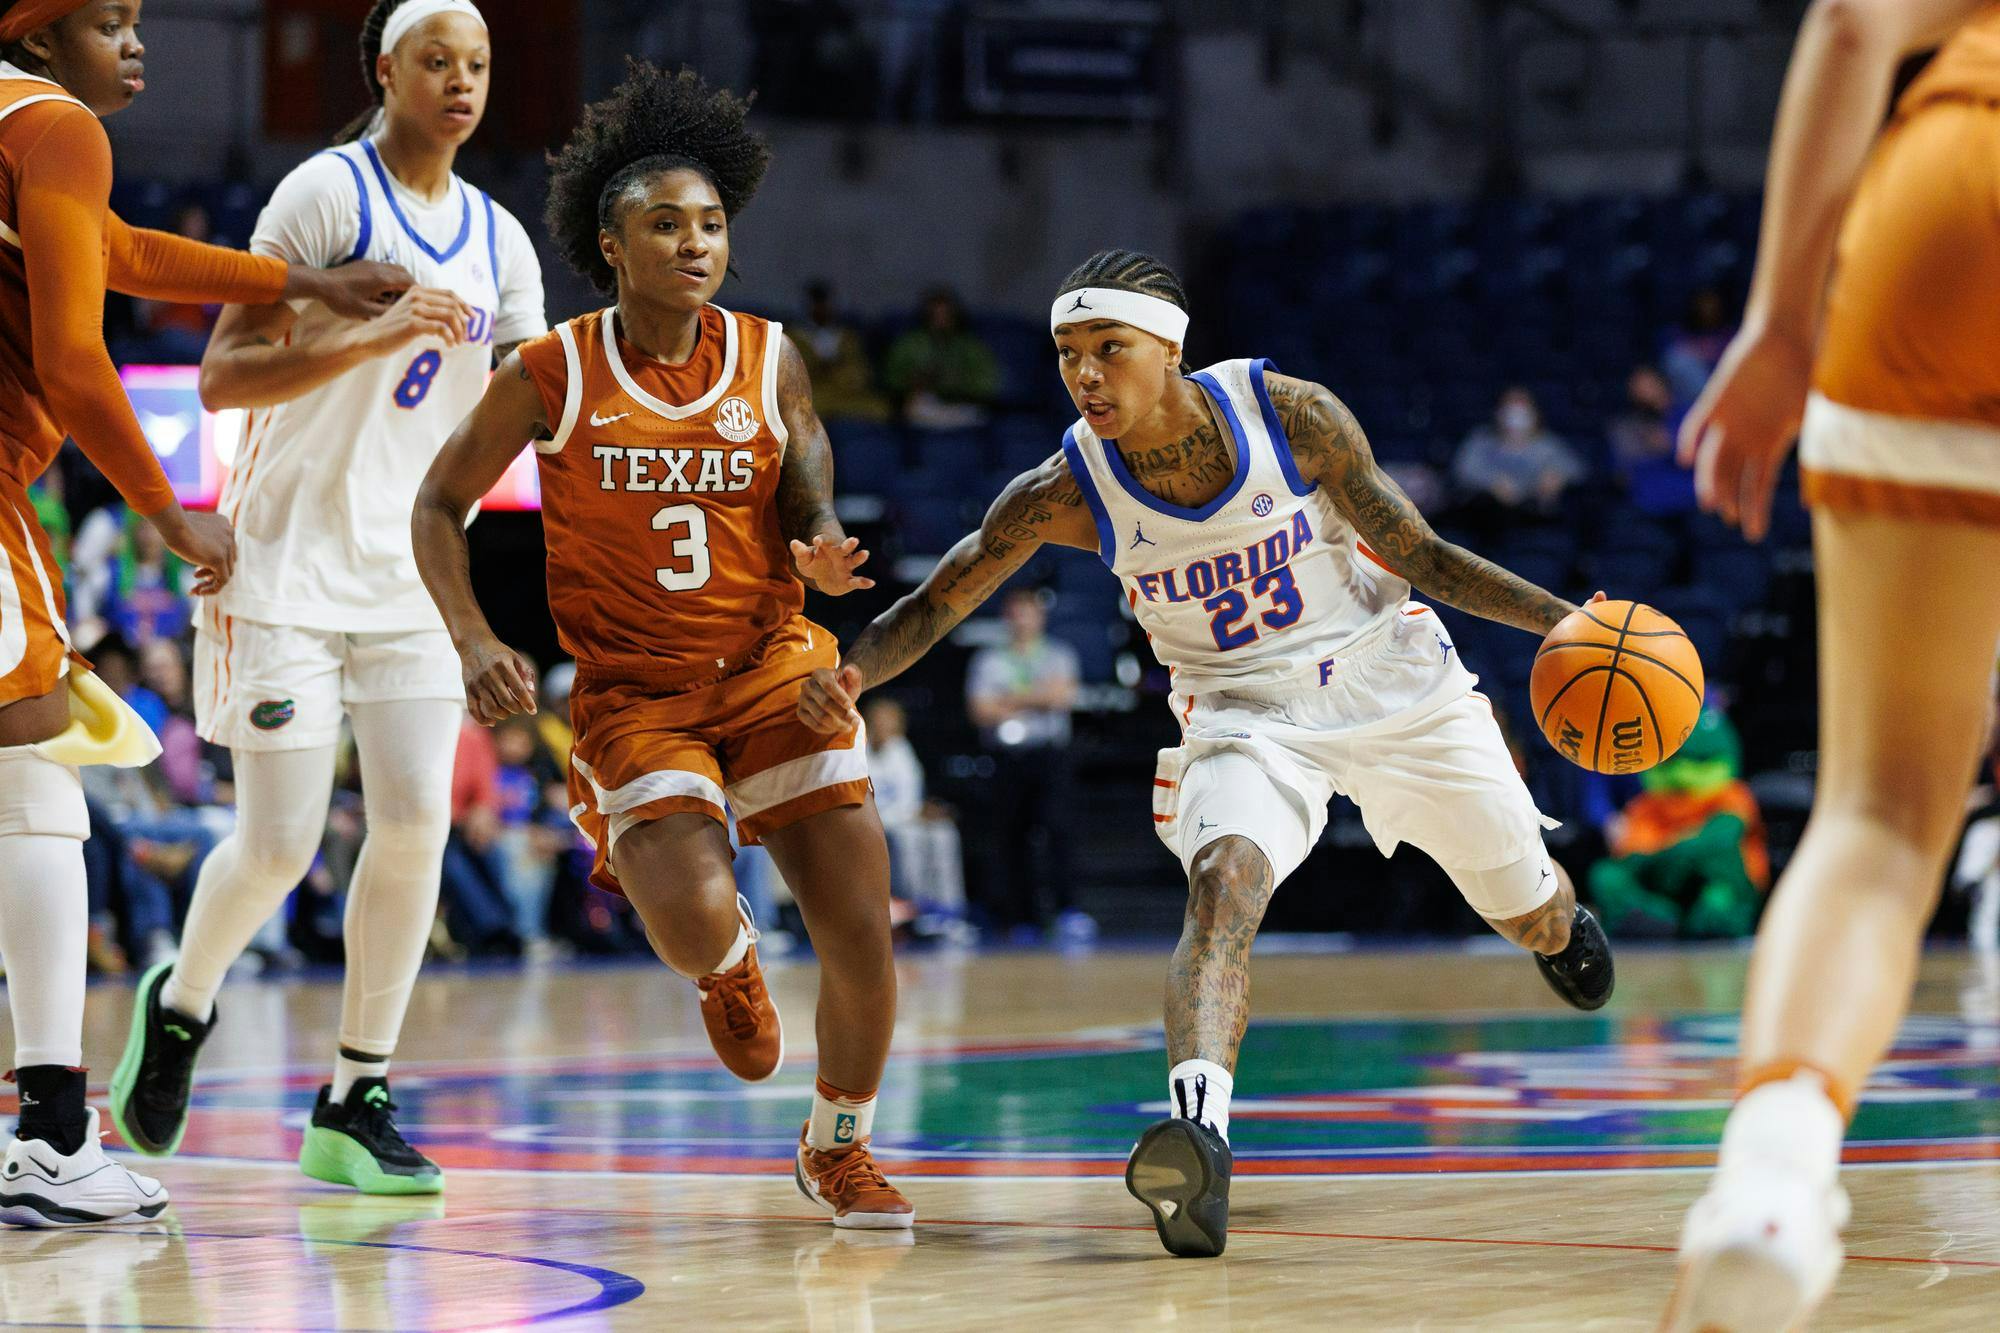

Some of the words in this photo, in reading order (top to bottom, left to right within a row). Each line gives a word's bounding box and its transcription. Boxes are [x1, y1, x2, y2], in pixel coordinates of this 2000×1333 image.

[393, 349, 442, 409] 8
[718, 422, 759, 441] GRADUATE
[720, 399, 751, 431] SEC
[592, 445, 755, 493] TEXAS
[1254, 495, 1272, 516] SEC
[651, 503, 712, 592] 3
[1134, 509, 1314, 603] FLORIDA
[1203, 563, 1305, 652] 23
[1317, 658, 1335, 688] F
